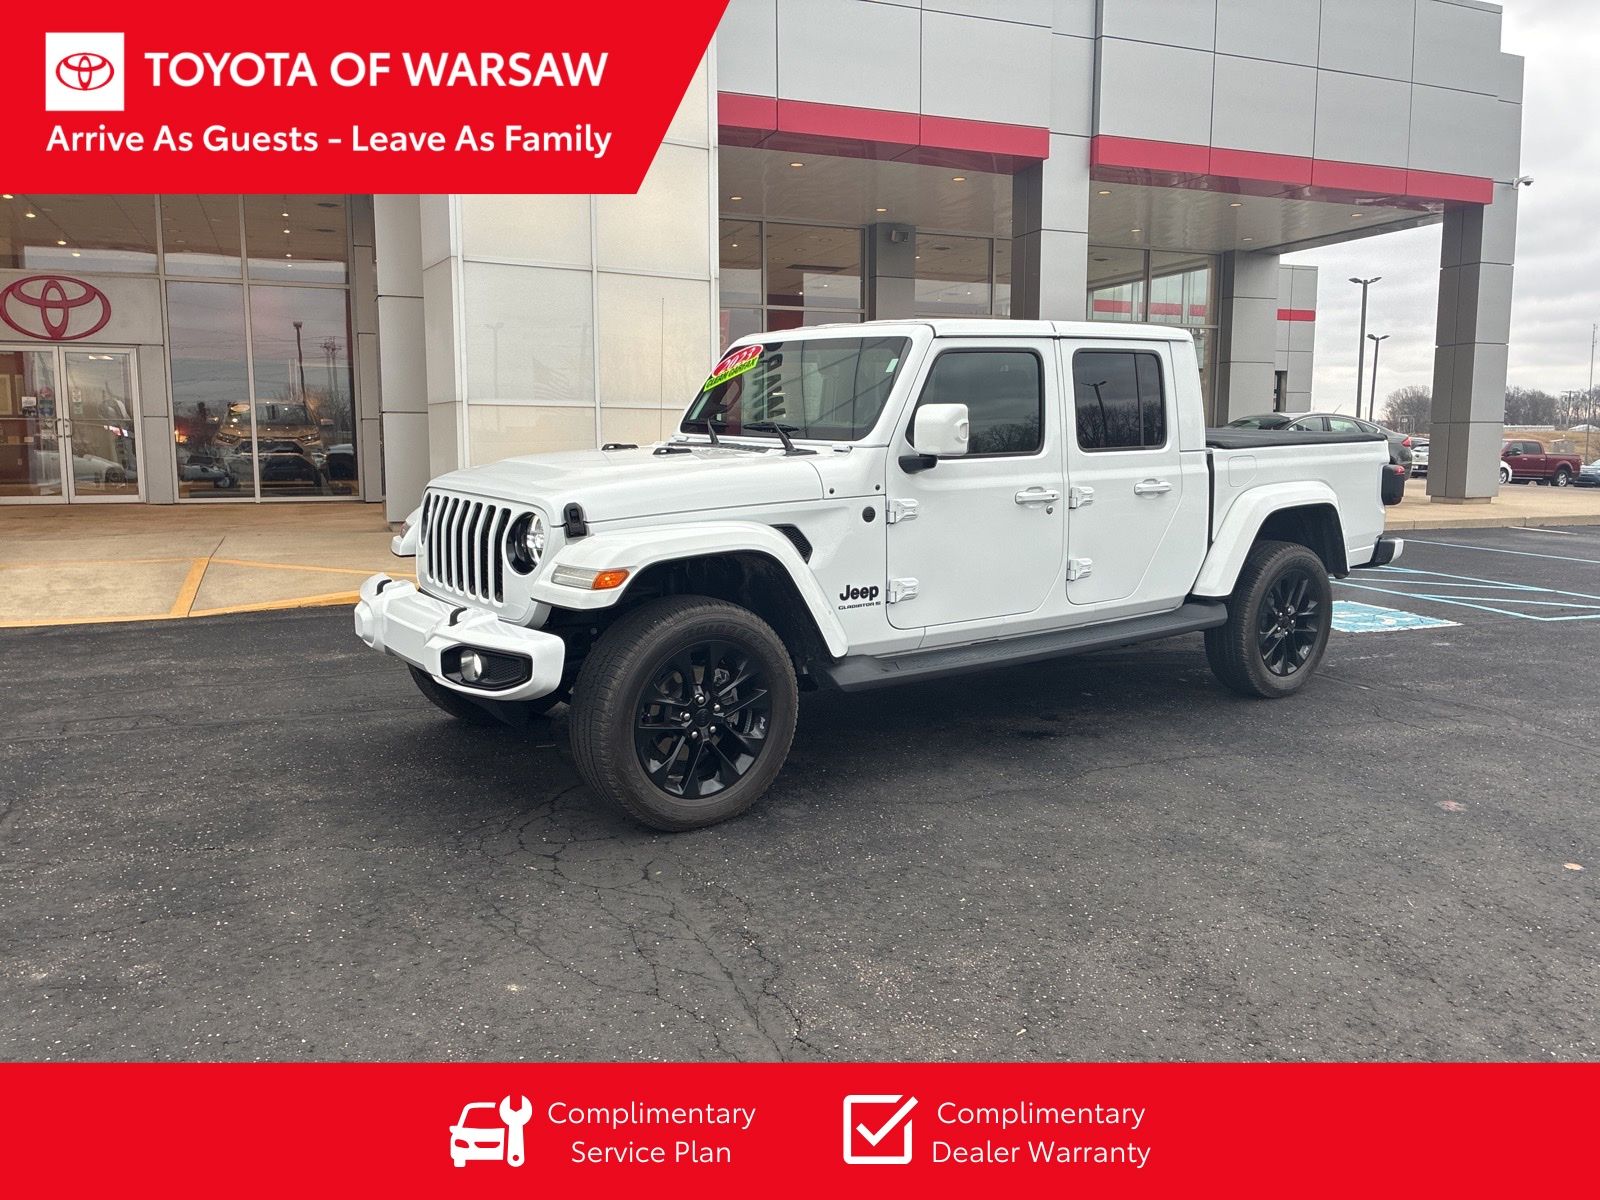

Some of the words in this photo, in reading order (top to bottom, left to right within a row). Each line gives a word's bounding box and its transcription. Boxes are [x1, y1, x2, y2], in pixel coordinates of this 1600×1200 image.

[722, 347, 756, 371] 2023
[839, 585, 879, 601] Jeep
[838, 602, 875, 610] GLADIATOR
